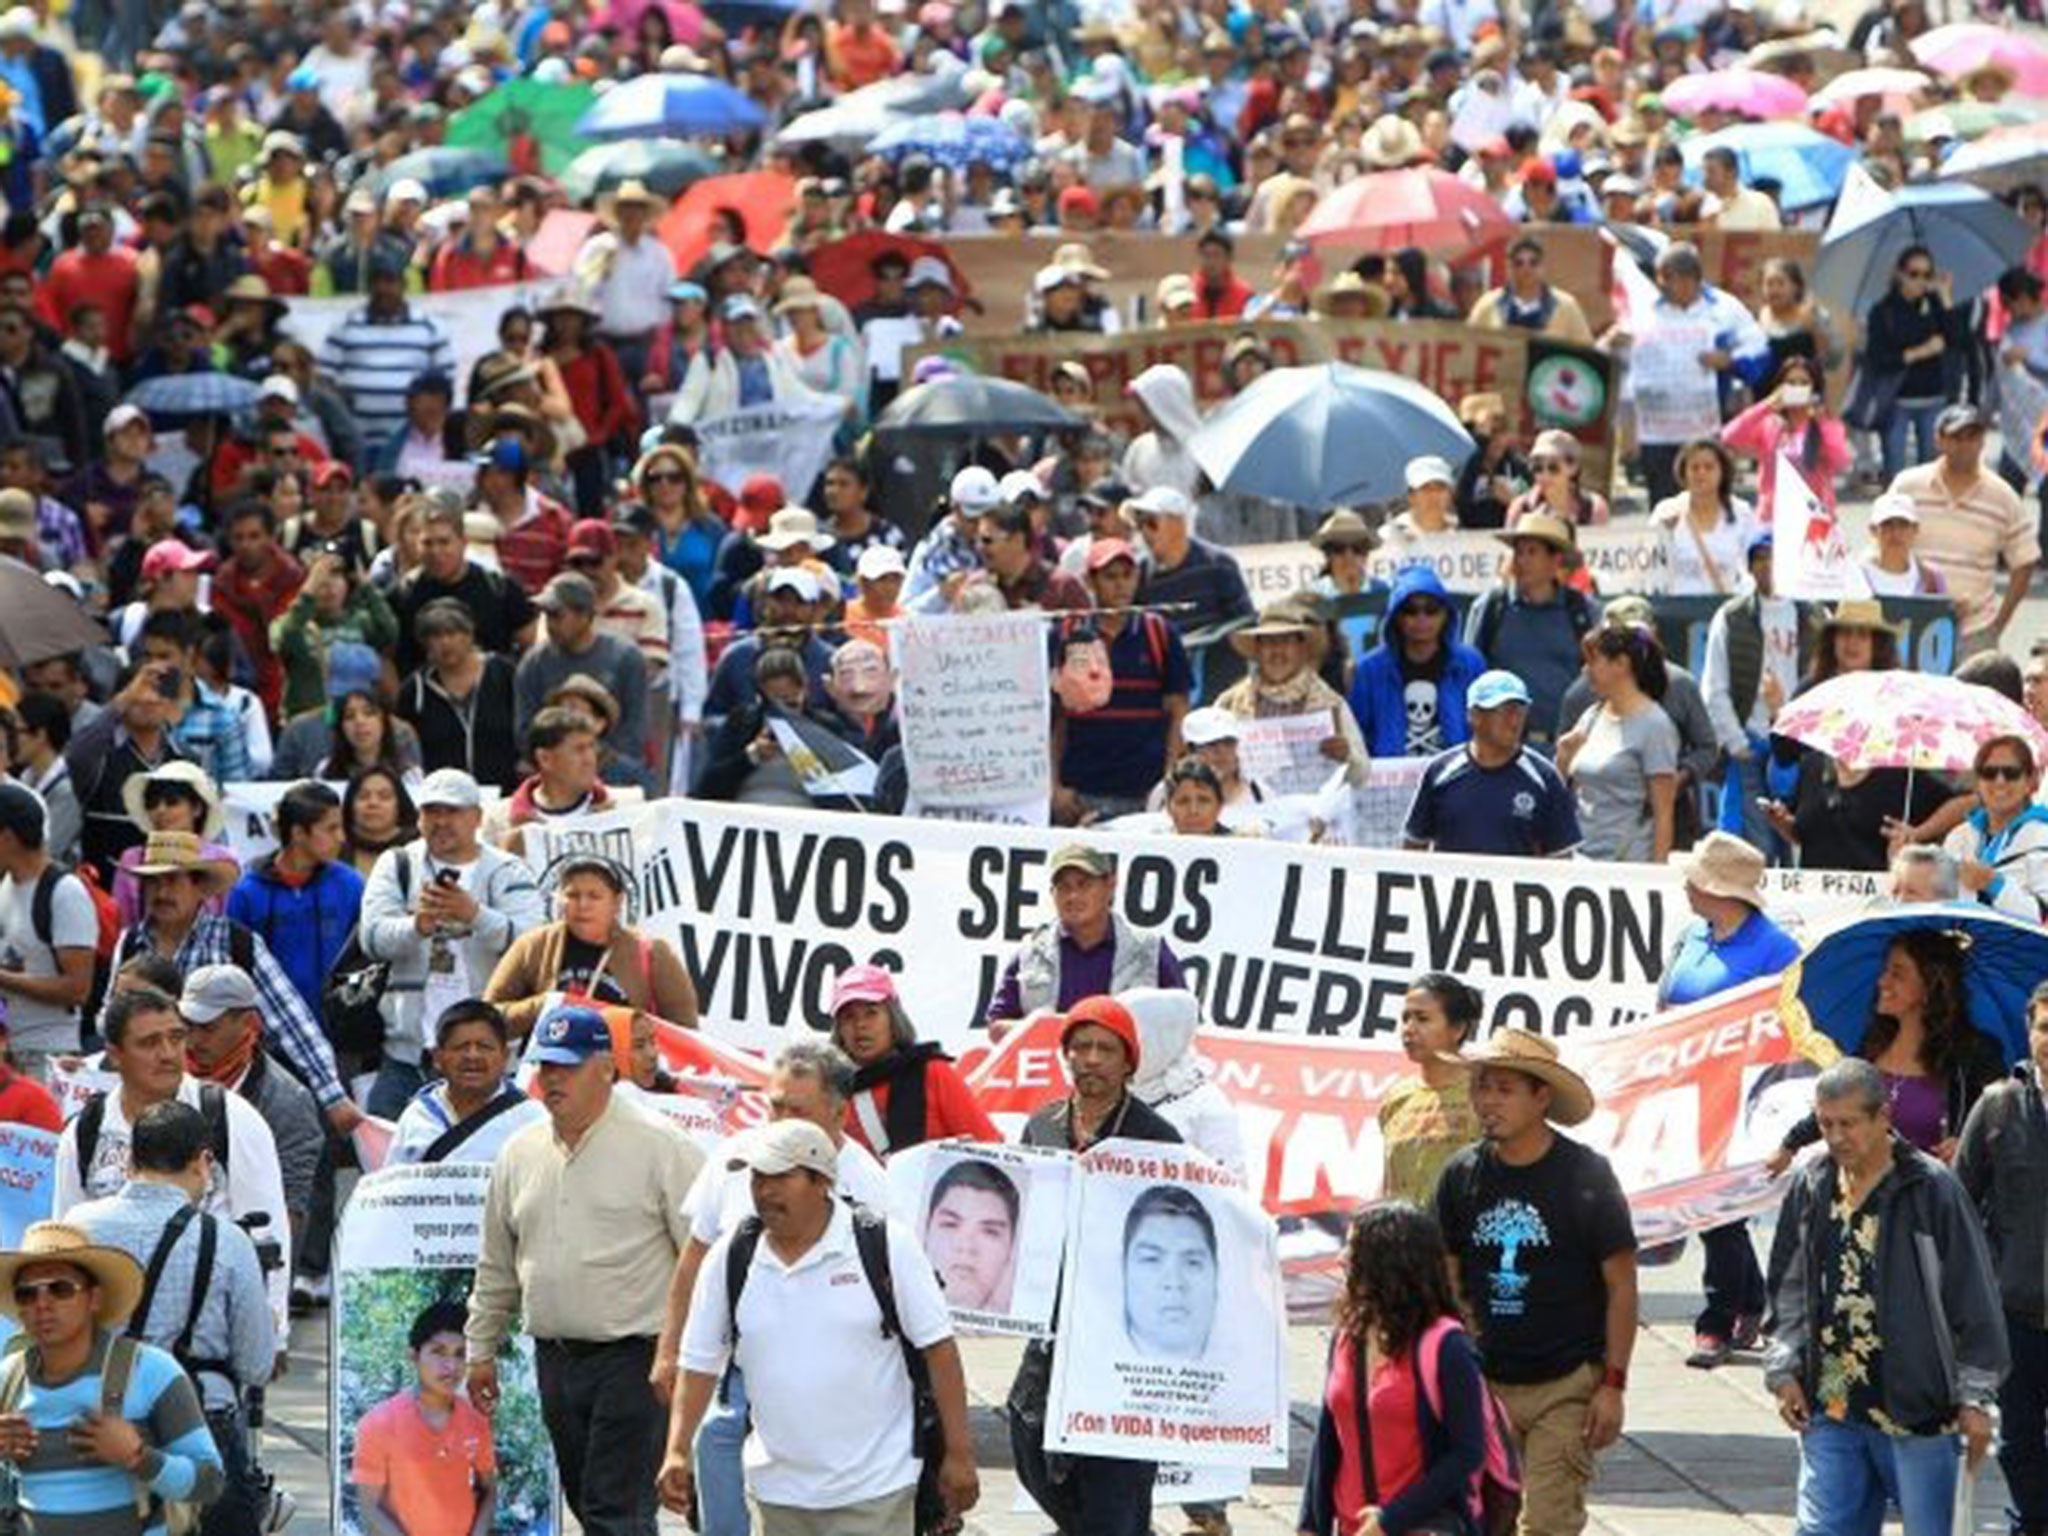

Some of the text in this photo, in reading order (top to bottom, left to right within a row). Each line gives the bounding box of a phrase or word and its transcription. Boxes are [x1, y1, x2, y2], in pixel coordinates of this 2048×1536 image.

[1781, 873, 1801, 893] DE
[957, 846, 1048, 941] SE
[1102, 853, 1219, 943] OS
[1273, 864, 1664, 984] LLEVARON
[1637, 1008, 1784, 1073] QUER
[1138, 1159, 1157, 1178] se
[1111, 1415, 1153, 1437] VIDA
[1159, 1417, 1175, 1439] lo
[1179, 1423, 1271, 1445] queremos!
